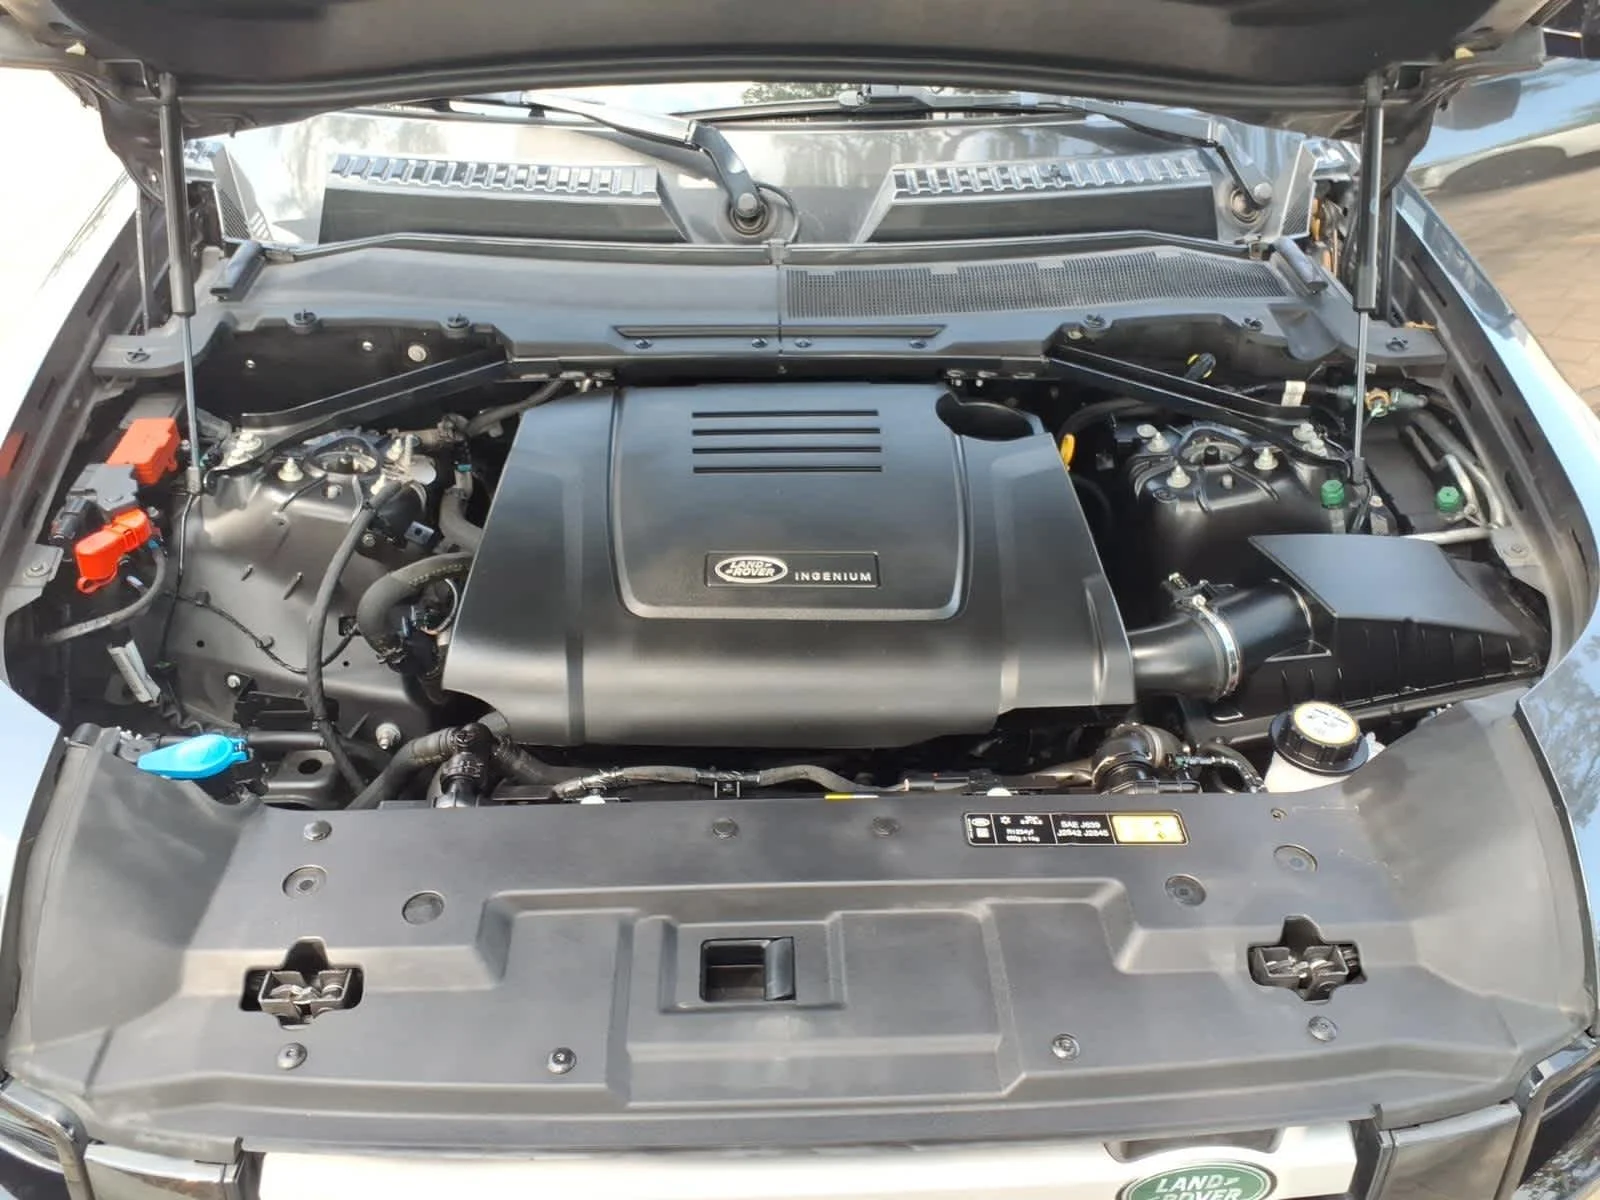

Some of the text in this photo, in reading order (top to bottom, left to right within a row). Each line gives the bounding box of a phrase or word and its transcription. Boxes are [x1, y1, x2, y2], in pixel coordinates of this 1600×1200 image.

[730, 560, 763, 569] LAND
[732, 568, 775, 577] ROVER
[795, 572, 872, 582] INGENIUM
[1156, 1174, 1224, 1193] LAND
